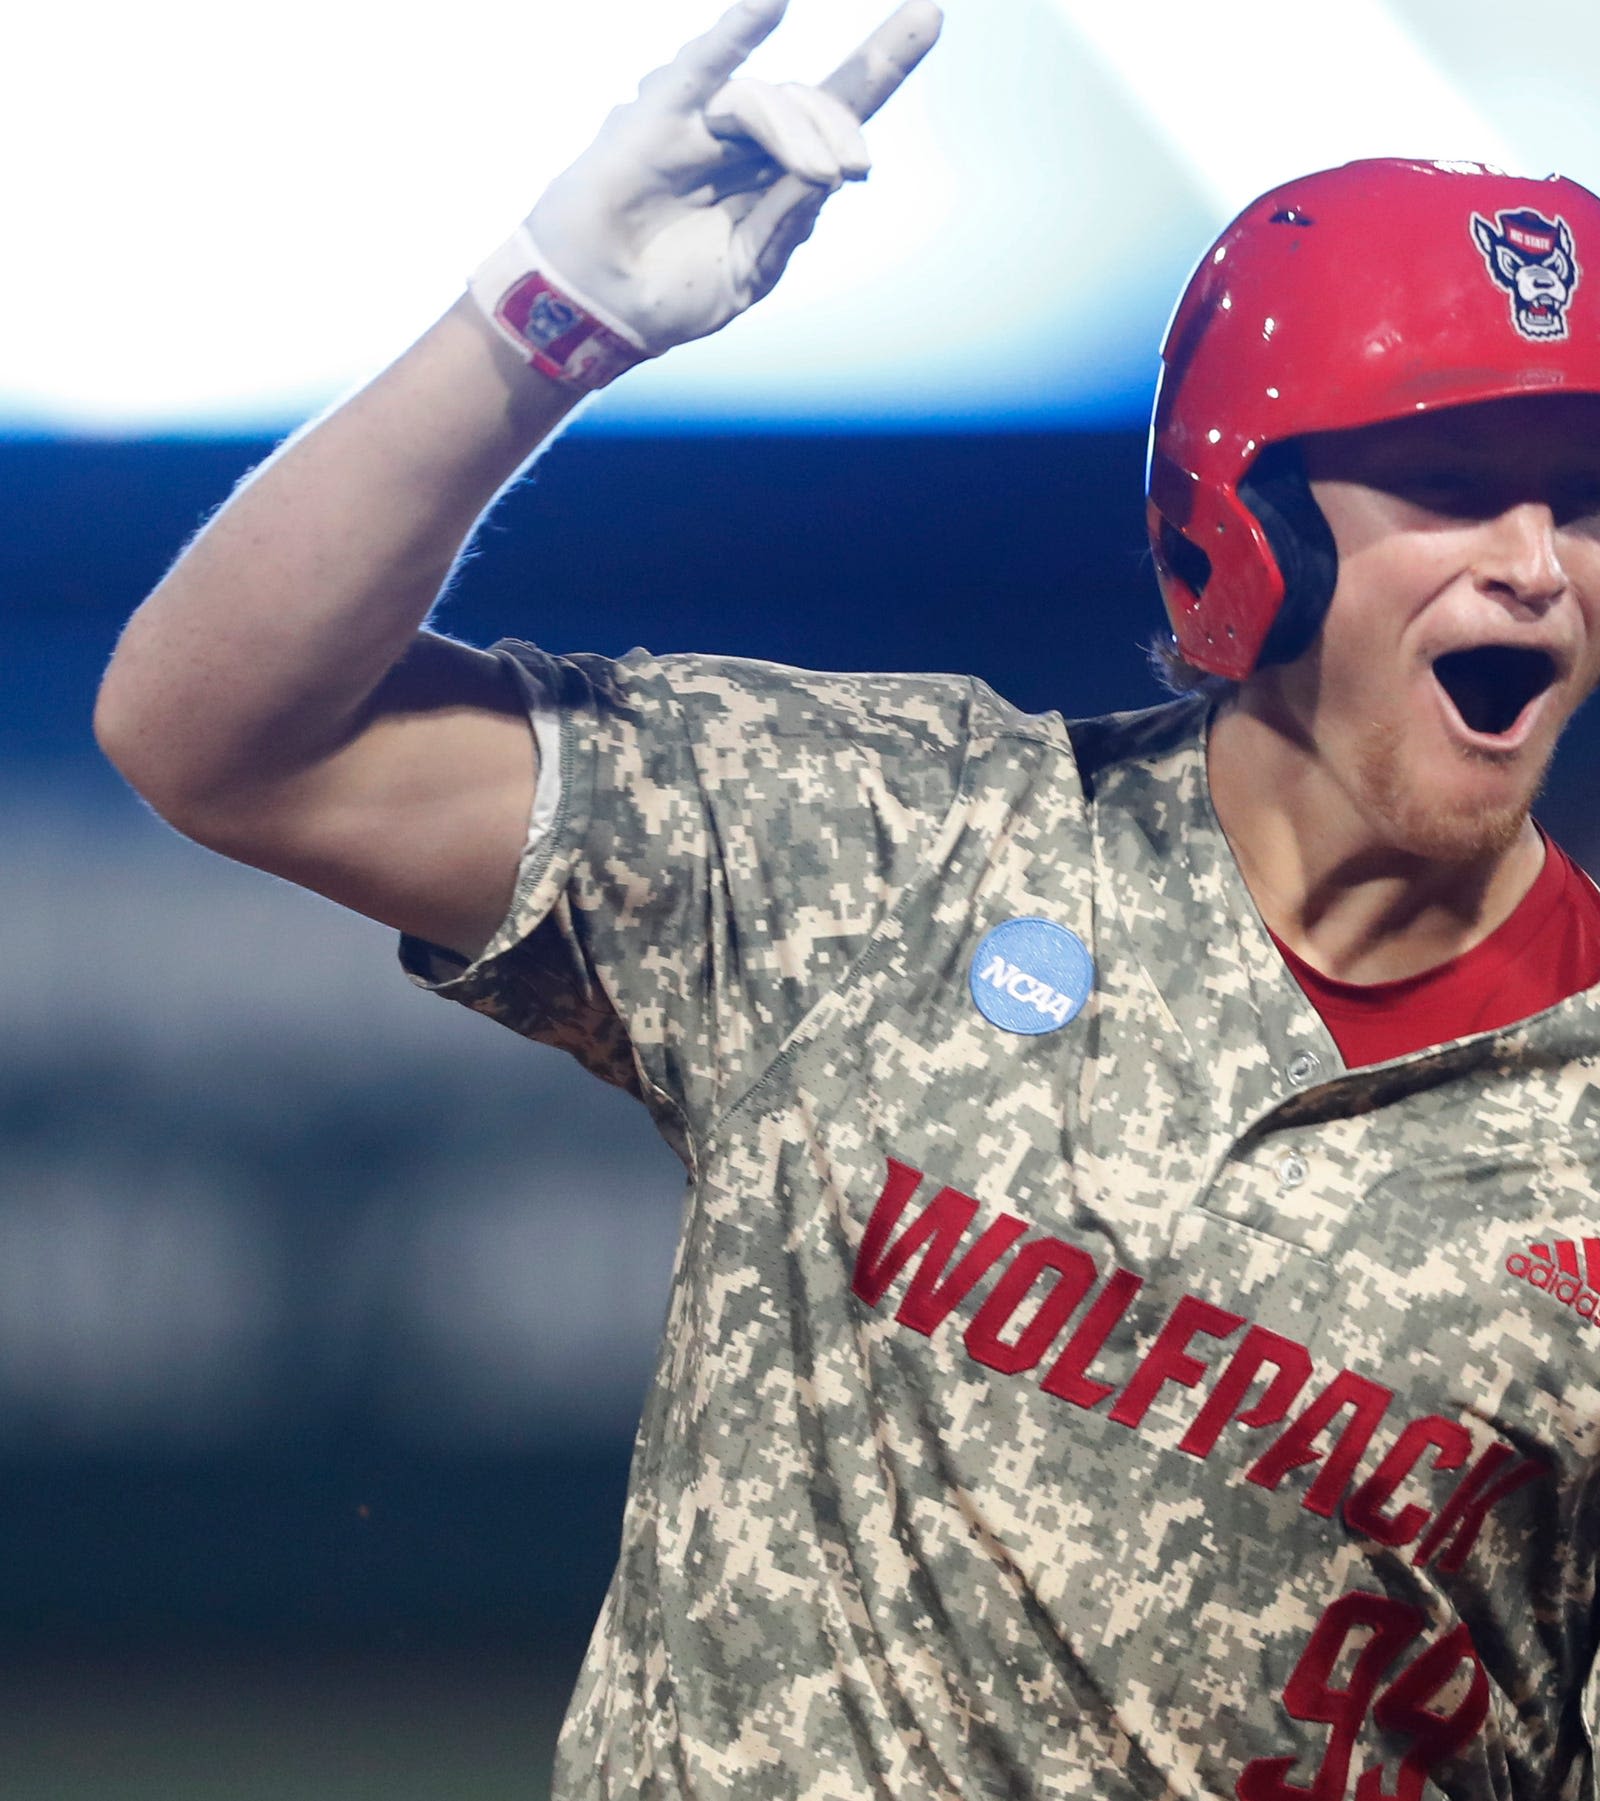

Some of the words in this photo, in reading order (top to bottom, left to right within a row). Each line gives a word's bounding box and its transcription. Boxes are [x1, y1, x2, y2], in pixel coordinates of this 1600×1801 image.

[979, 955, 1073, 1024] NCAA
[851, 1156, 1552, 1574] WOLFPACK
[1235, 1590, 1490, 1801] 99
